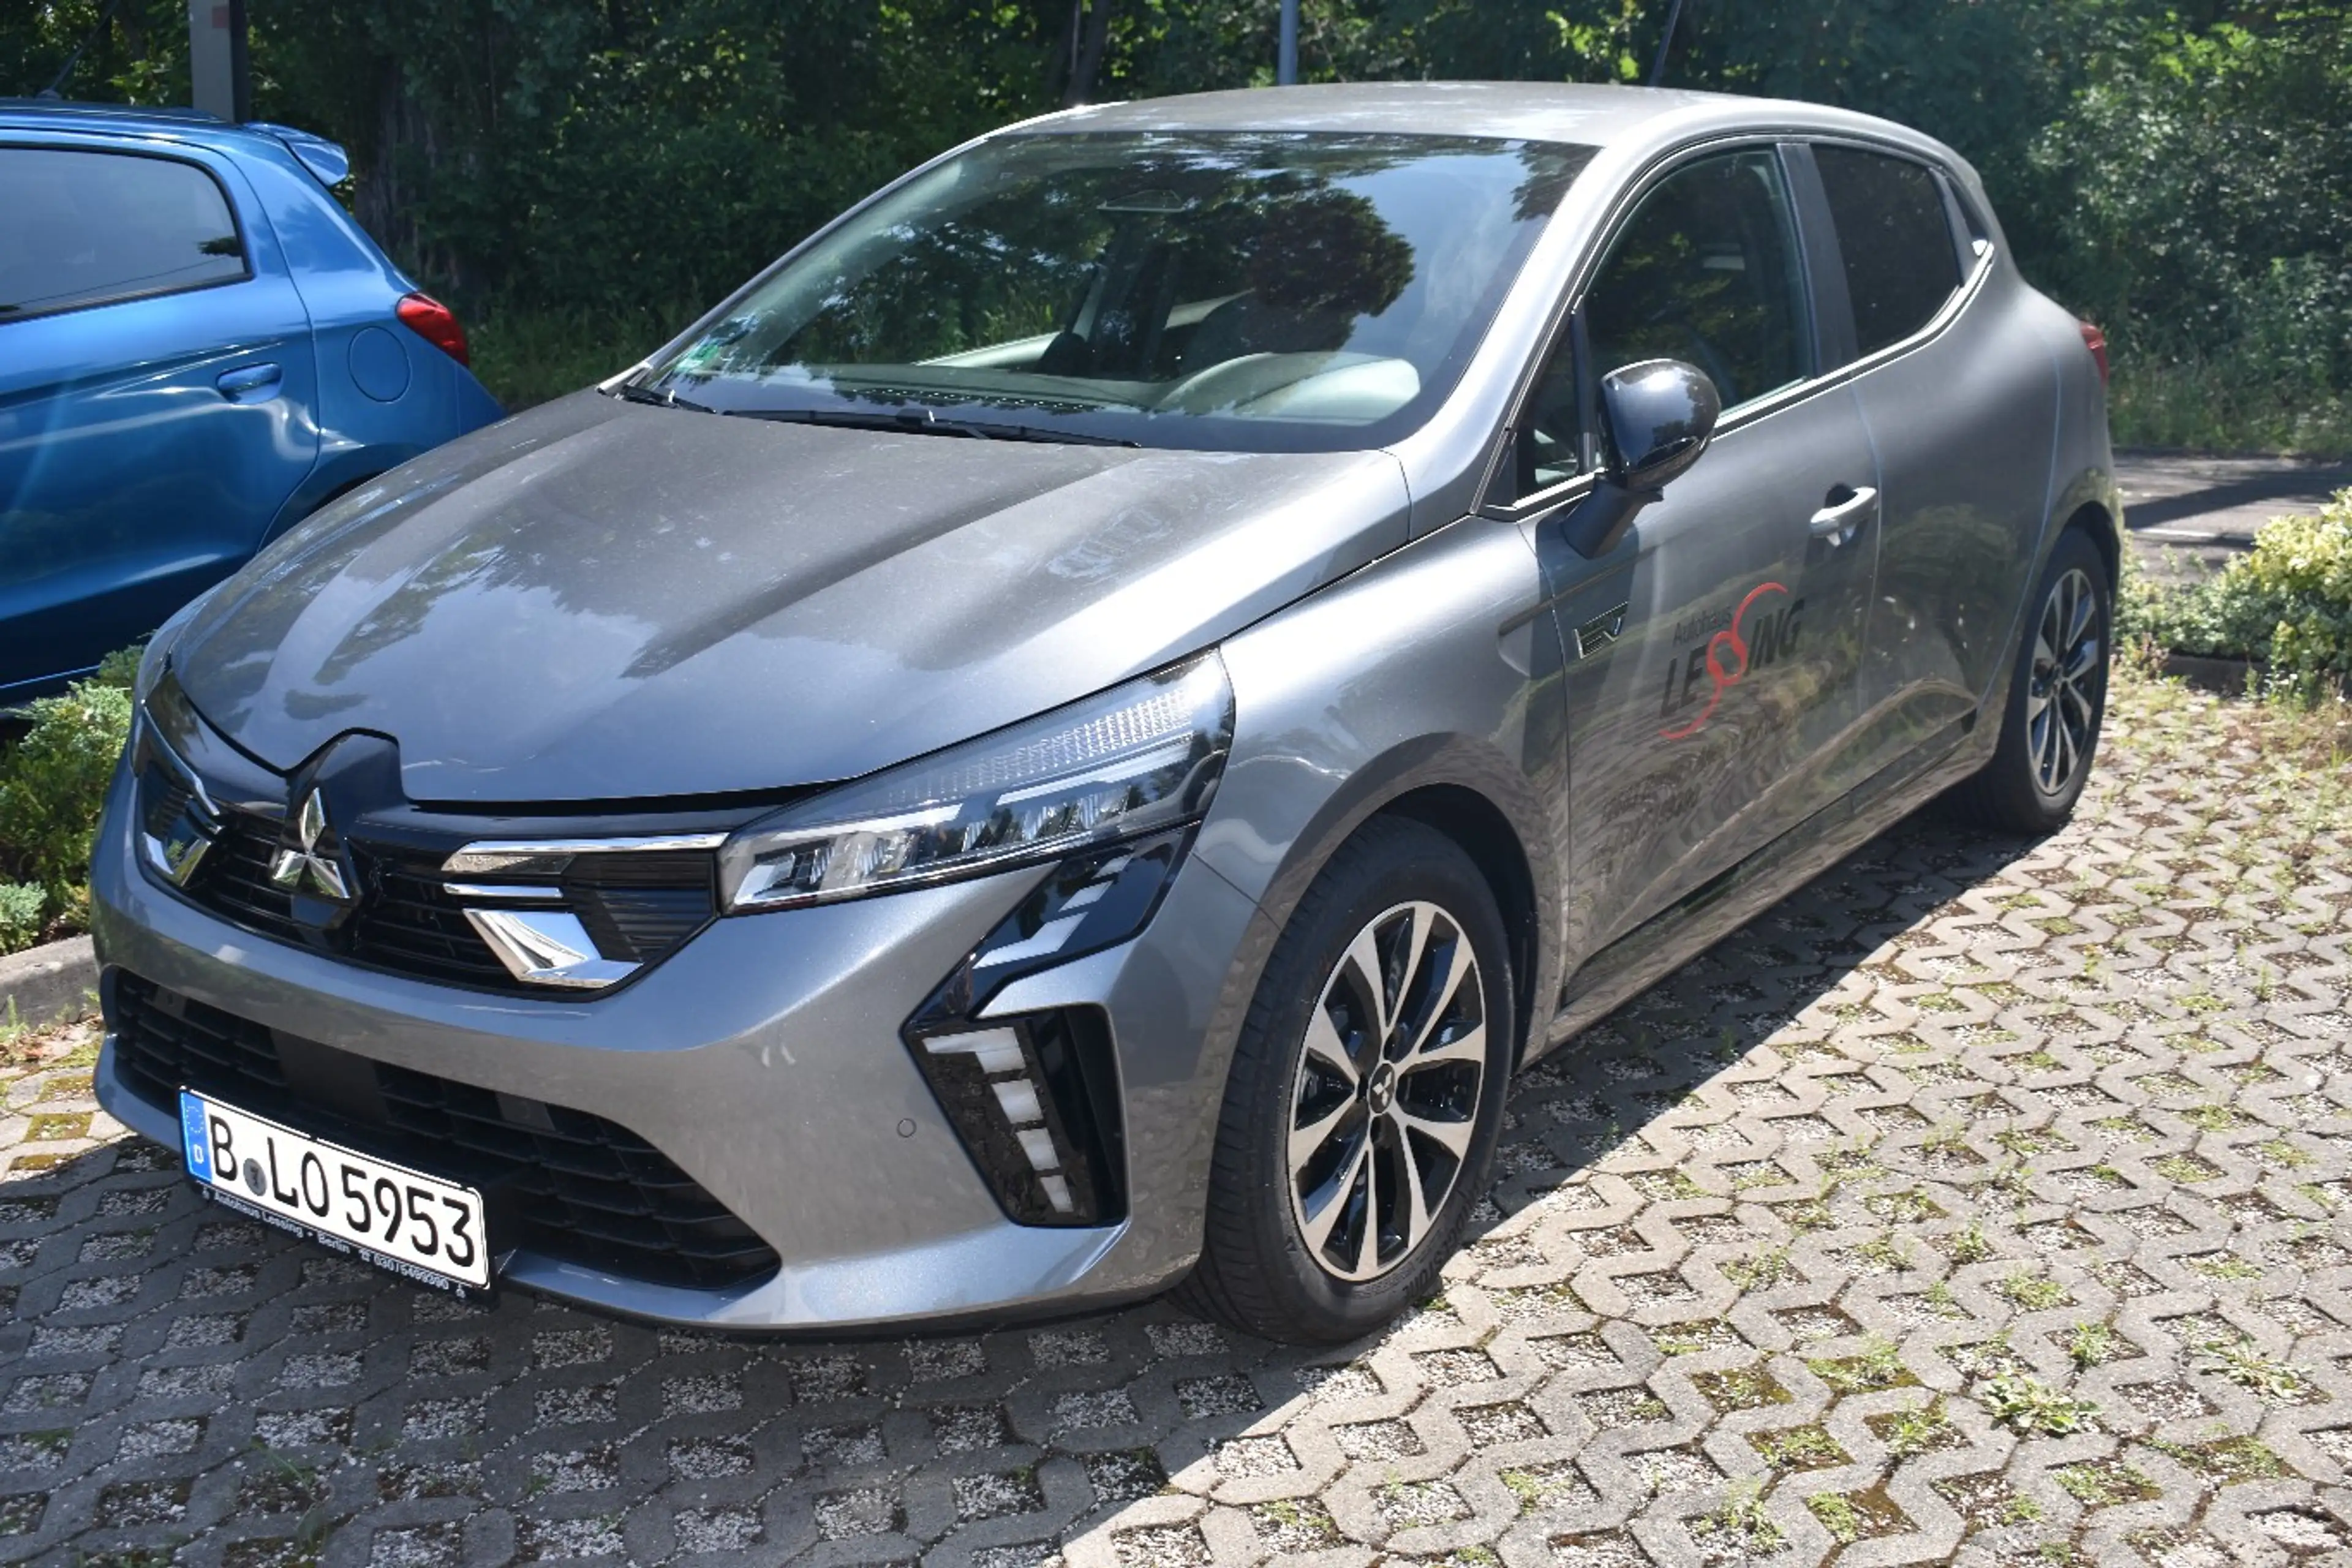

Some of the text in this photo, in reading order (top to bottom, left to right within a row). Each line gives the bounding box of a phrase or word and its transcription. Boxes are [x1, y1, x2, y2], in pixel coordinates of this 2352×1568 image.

[209, 1115, 475, 1268] B LO 5953
[317, 1231, 351, 1254] Berlin
